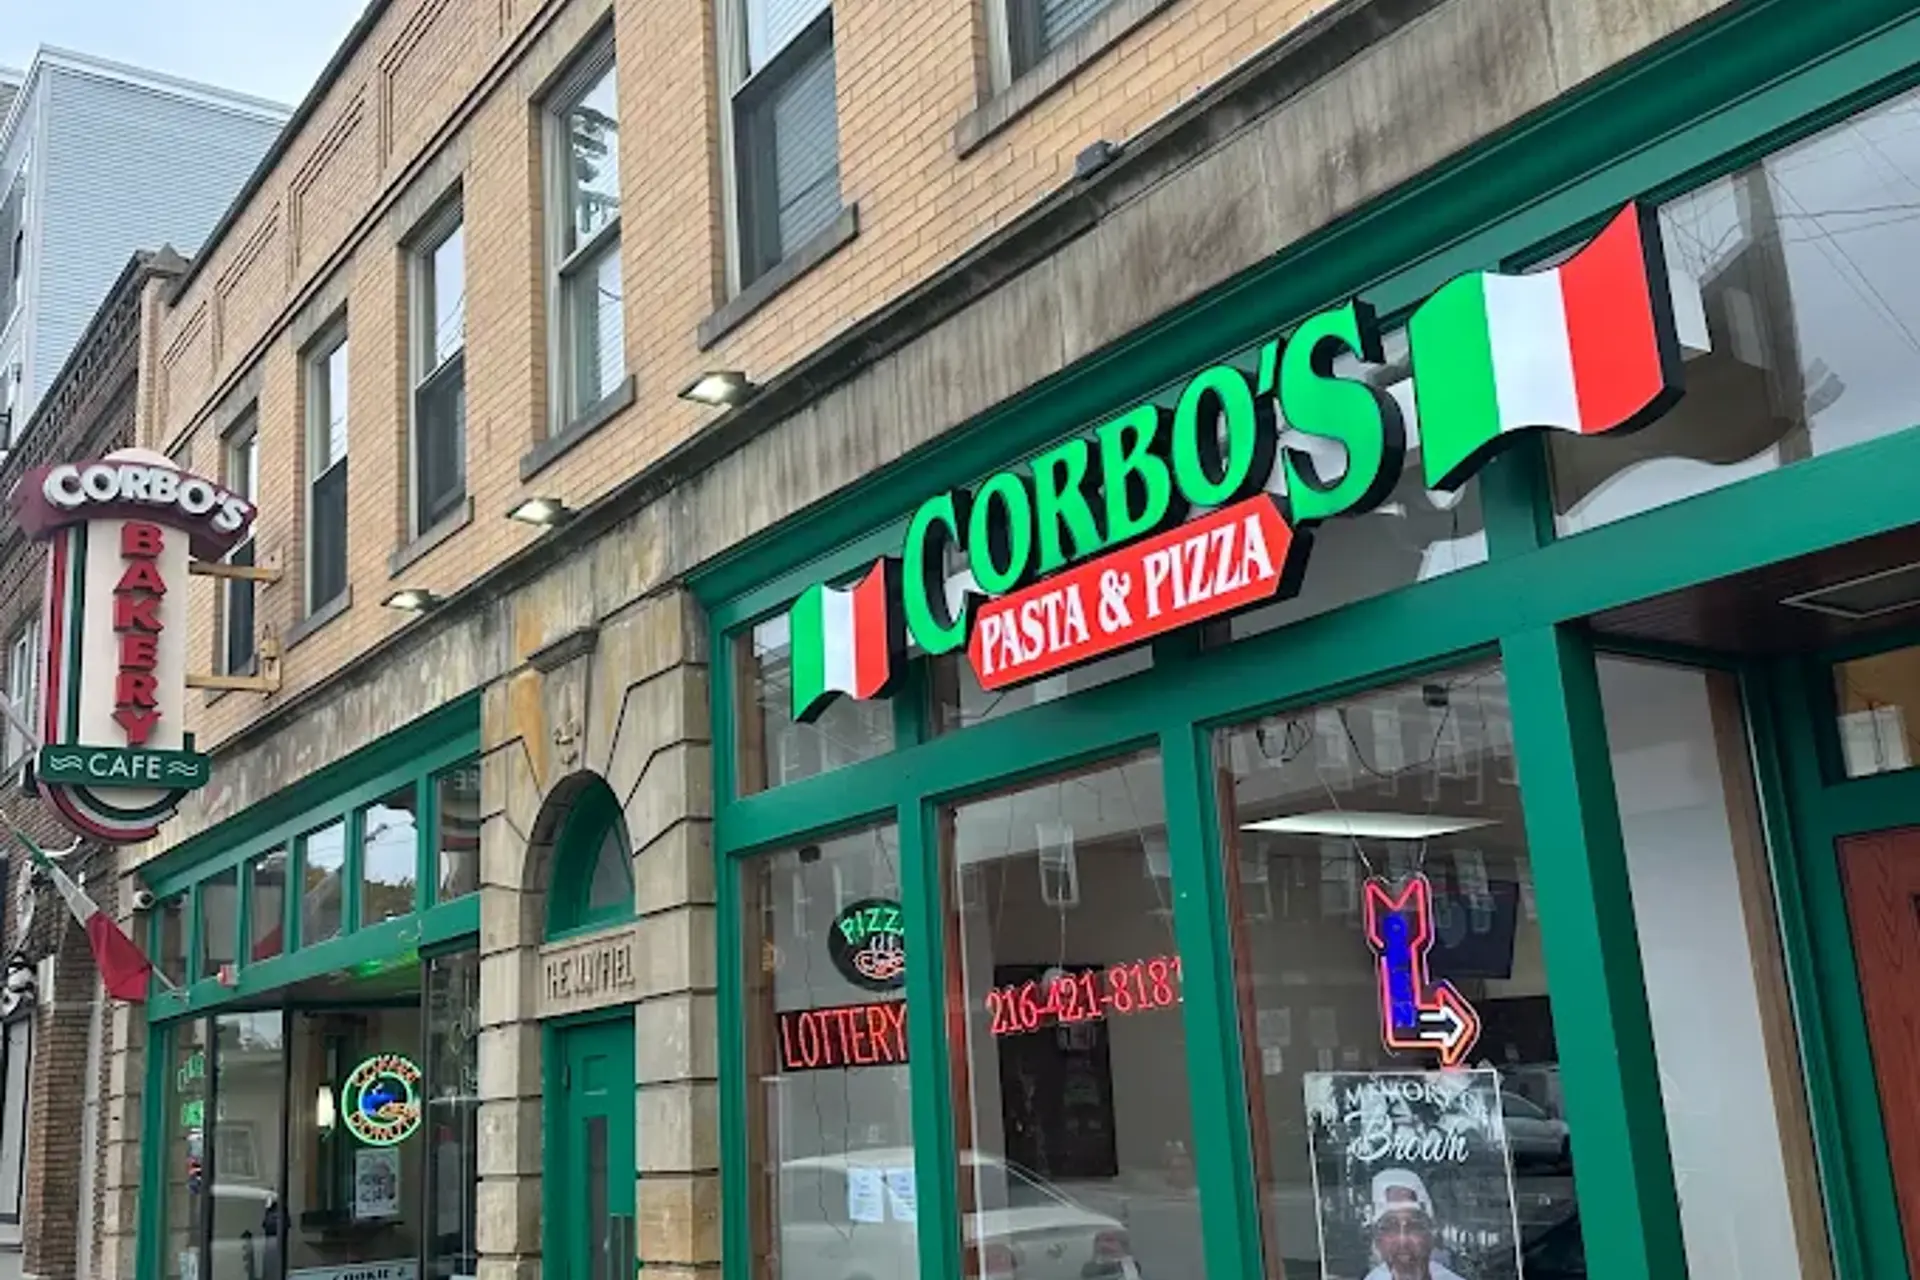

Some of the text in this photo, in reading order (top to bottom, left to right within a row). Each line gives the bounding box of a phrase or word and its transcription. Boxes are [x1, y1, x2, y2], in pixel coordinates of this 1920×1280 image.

[43, 464, 248, 532] CORBO'S
[902, 299, 1383, 655] CORBO'S
[979, 513, 1275, 676] PASTA & PIZZA
[112, 521, 167, 746] BAKERY
[88, 752, 162, 780] CAFE
[839, 907, 905, 945] PIZZ
[781, 1003, 907, 1068] LOTTERY
